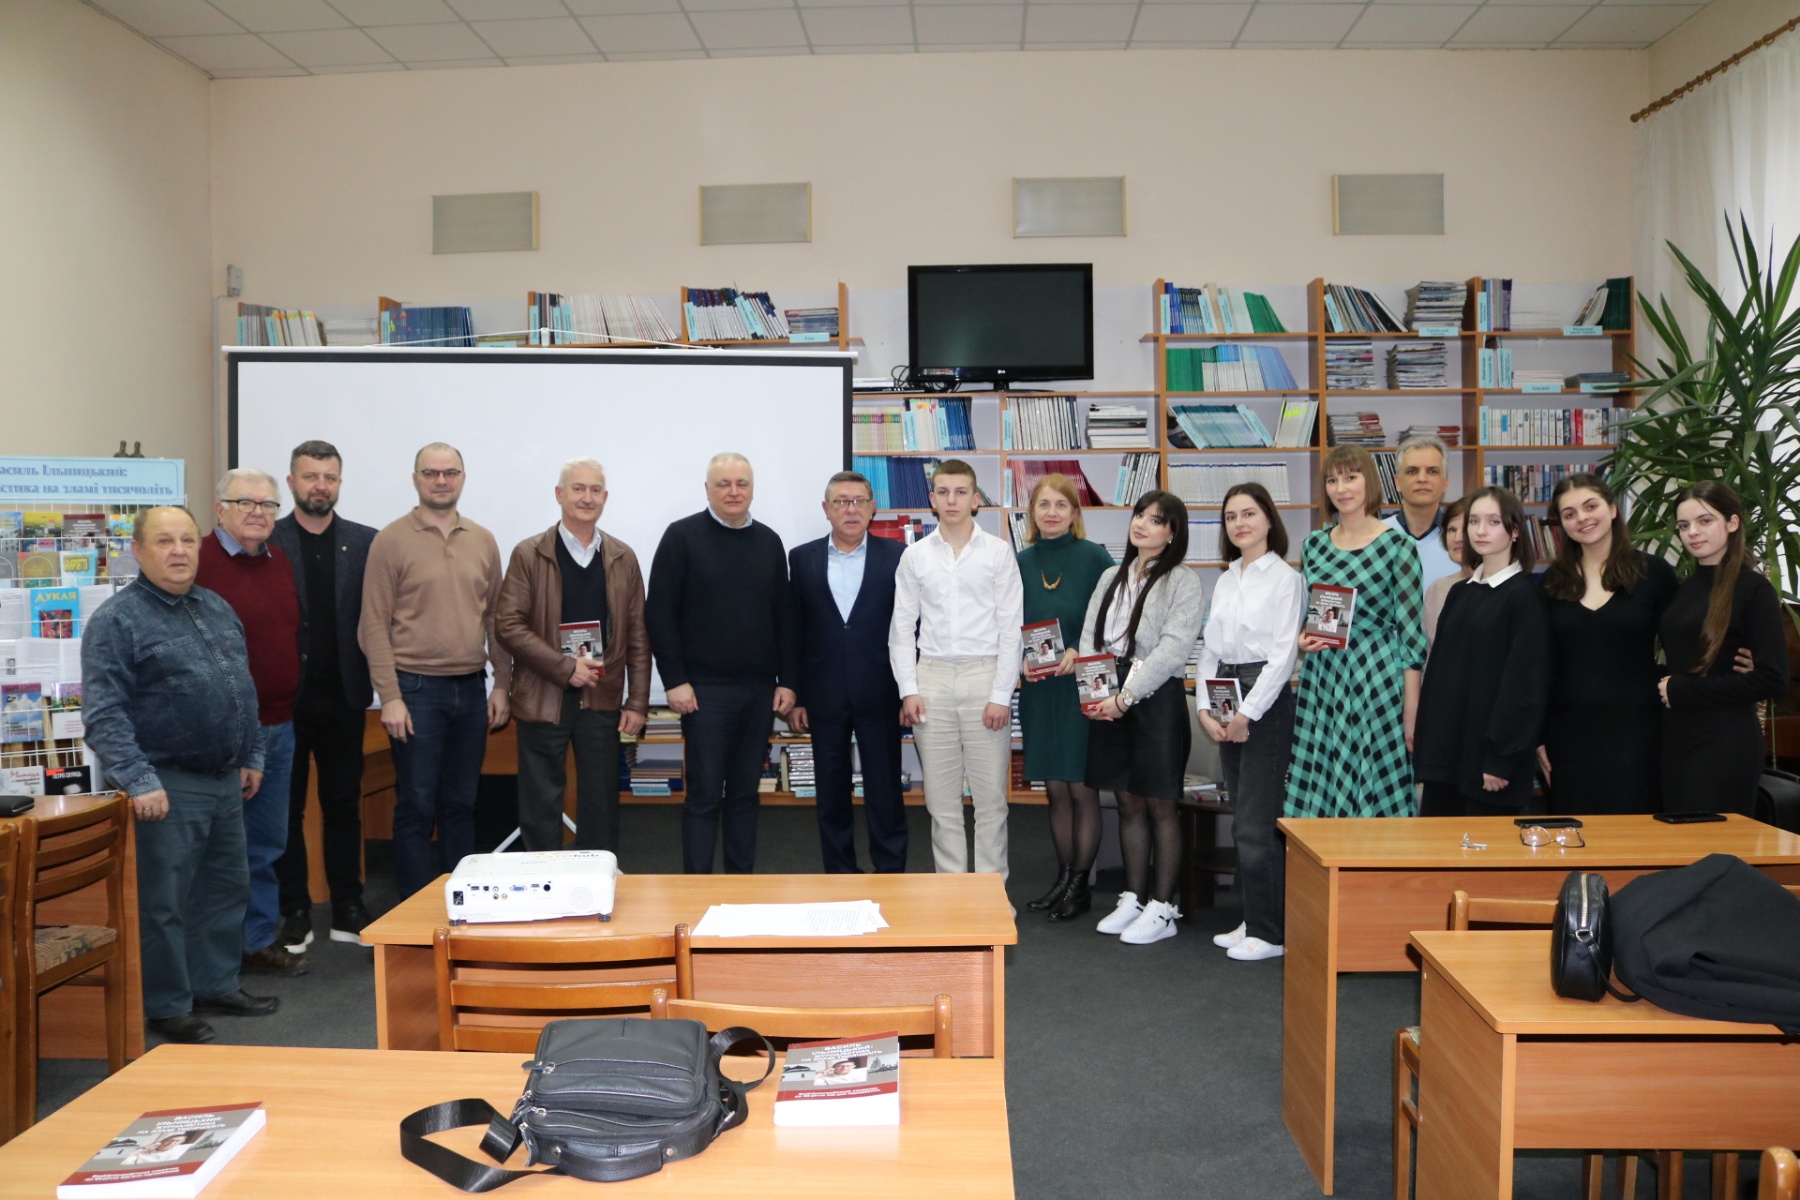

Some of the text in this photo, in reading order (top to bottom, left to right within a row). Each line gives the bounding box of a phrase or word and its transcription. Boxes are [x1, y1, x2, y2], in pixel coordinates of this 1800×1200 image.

[43, 485, 59, 494] на
[63, 482, 99, 495] зламі
[101, 483, 173, 495] тисячоліть
